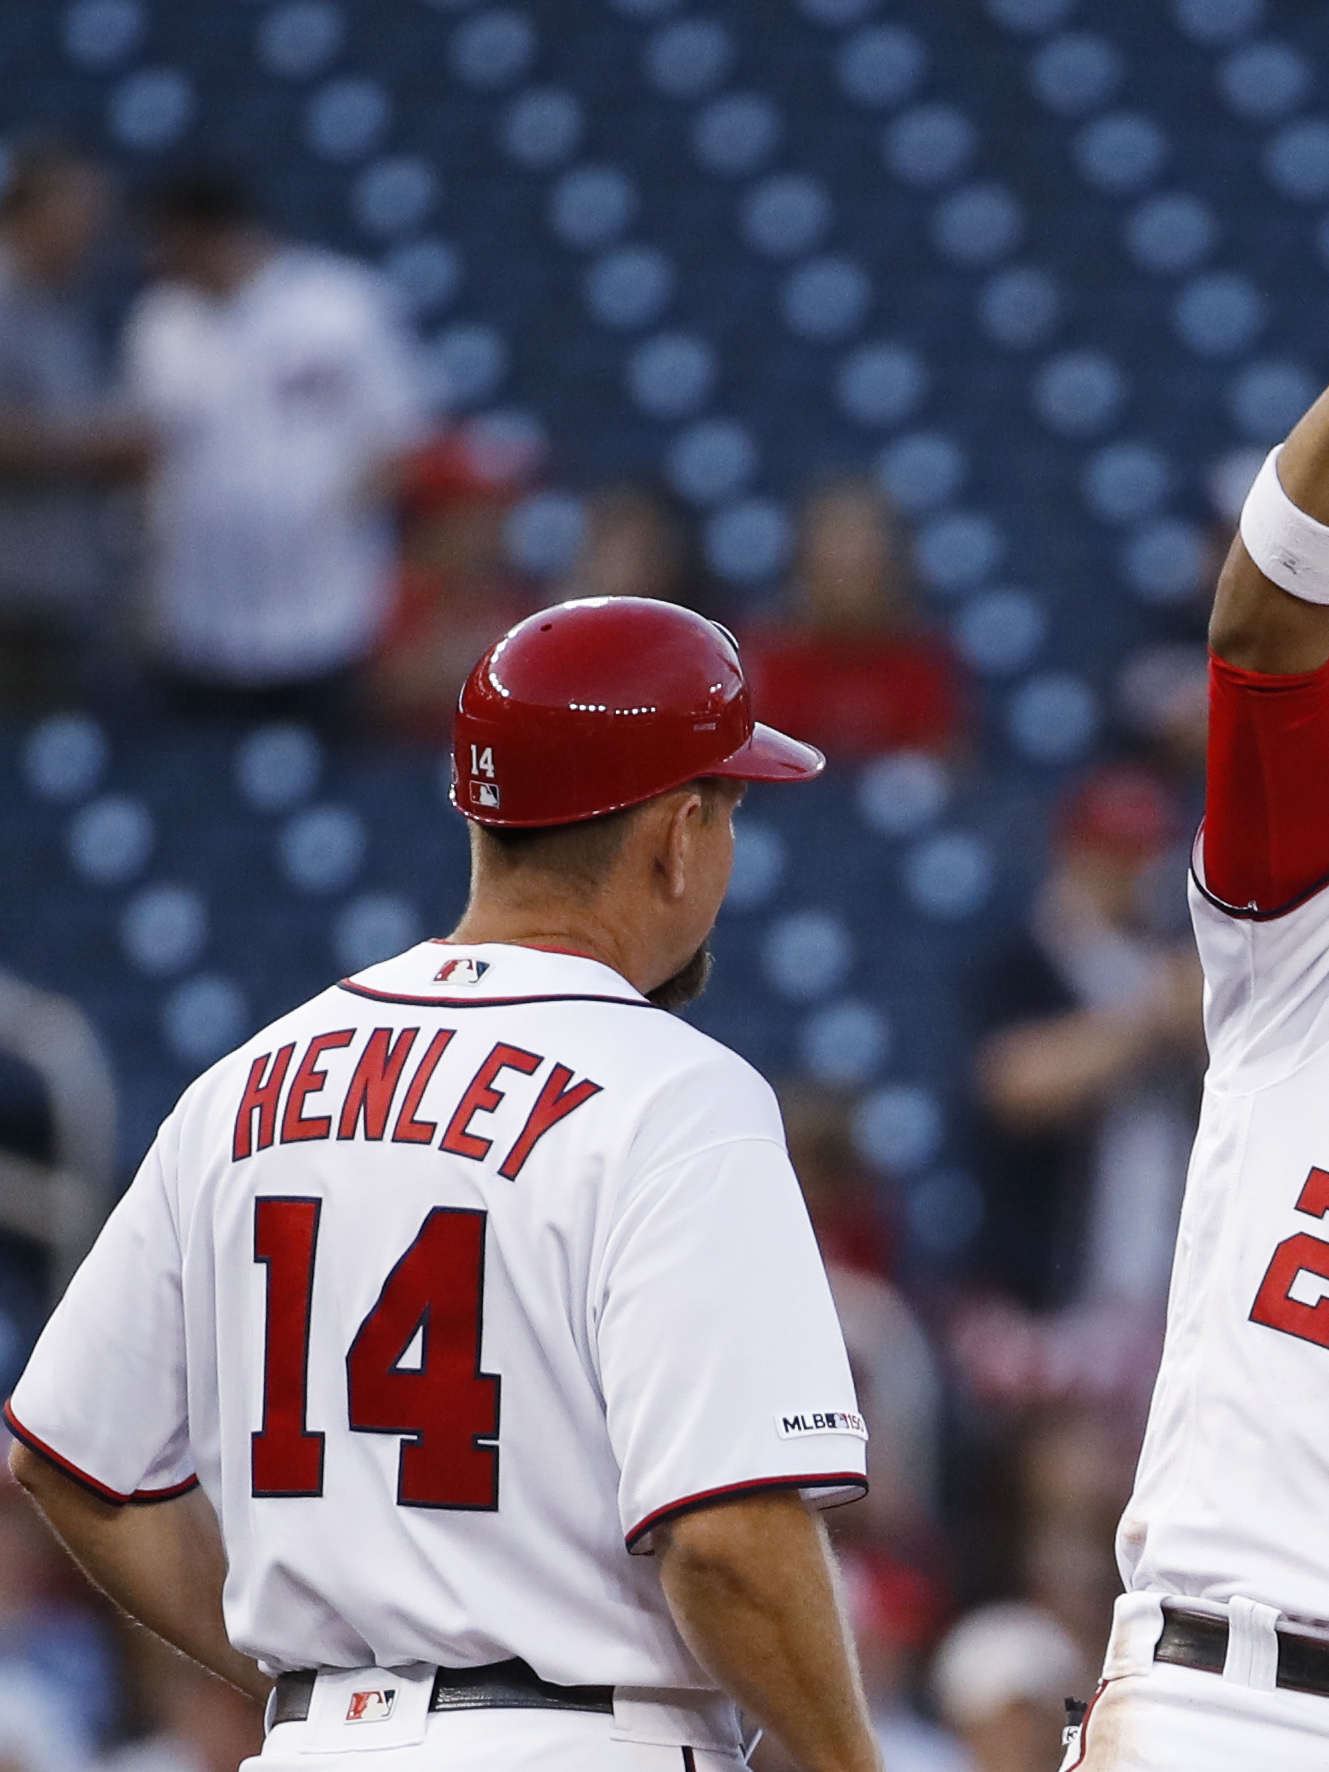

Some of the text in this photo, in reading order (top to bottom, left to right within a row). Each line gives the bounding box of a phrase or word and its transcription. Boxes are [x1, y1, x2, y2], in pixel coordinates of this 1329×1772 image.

[470, 744, 495, 778] 14
[232, 1027, 604, 1182] HENLEY
[251, 1196, 501, 1512] 14
[782, 1413, 826, 1433] MLB
